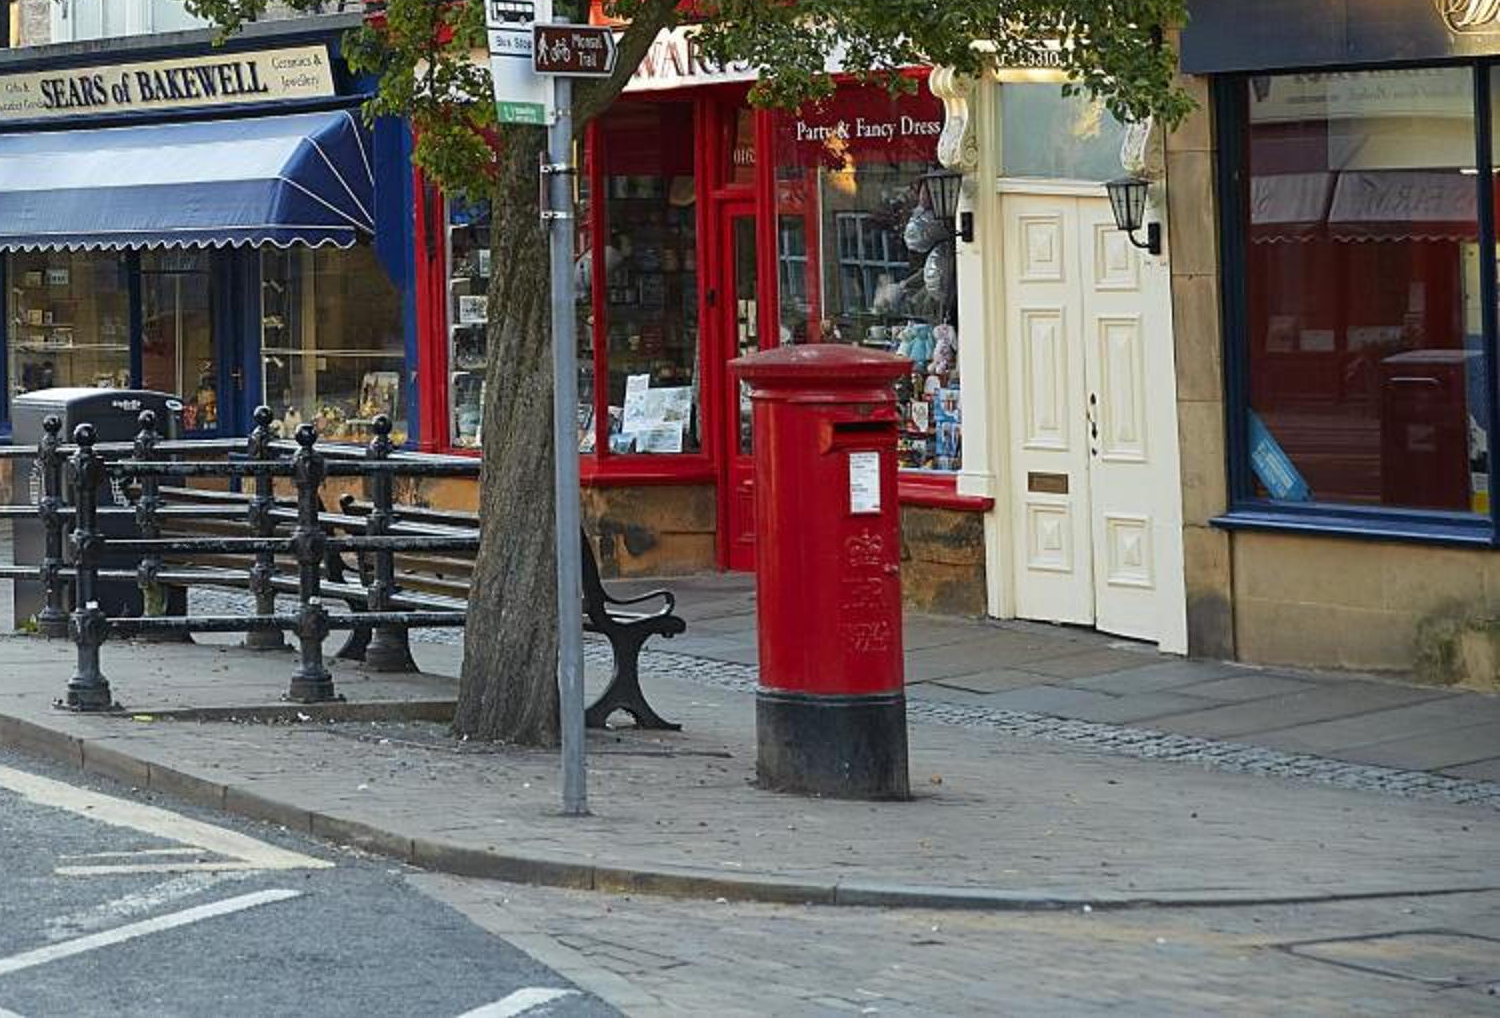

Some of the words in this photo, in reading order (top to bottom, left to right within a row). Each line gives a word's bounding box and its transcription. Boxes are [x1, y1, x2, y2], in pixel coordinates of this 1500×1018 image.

[495, 35, 512, 47] Bus
[572, 33, 603, 49] Monsal
[577, 51, 597, 67] Trail
[40, 76, 108, 109] SEARS
[111, 72, 133, 104] of
[134, 61, 269, 101] BAKEWELL
[837, 119, 850, 139] &
[856, 118, 896, 142] Fancy
[901, 115, 941, 136] Dress
